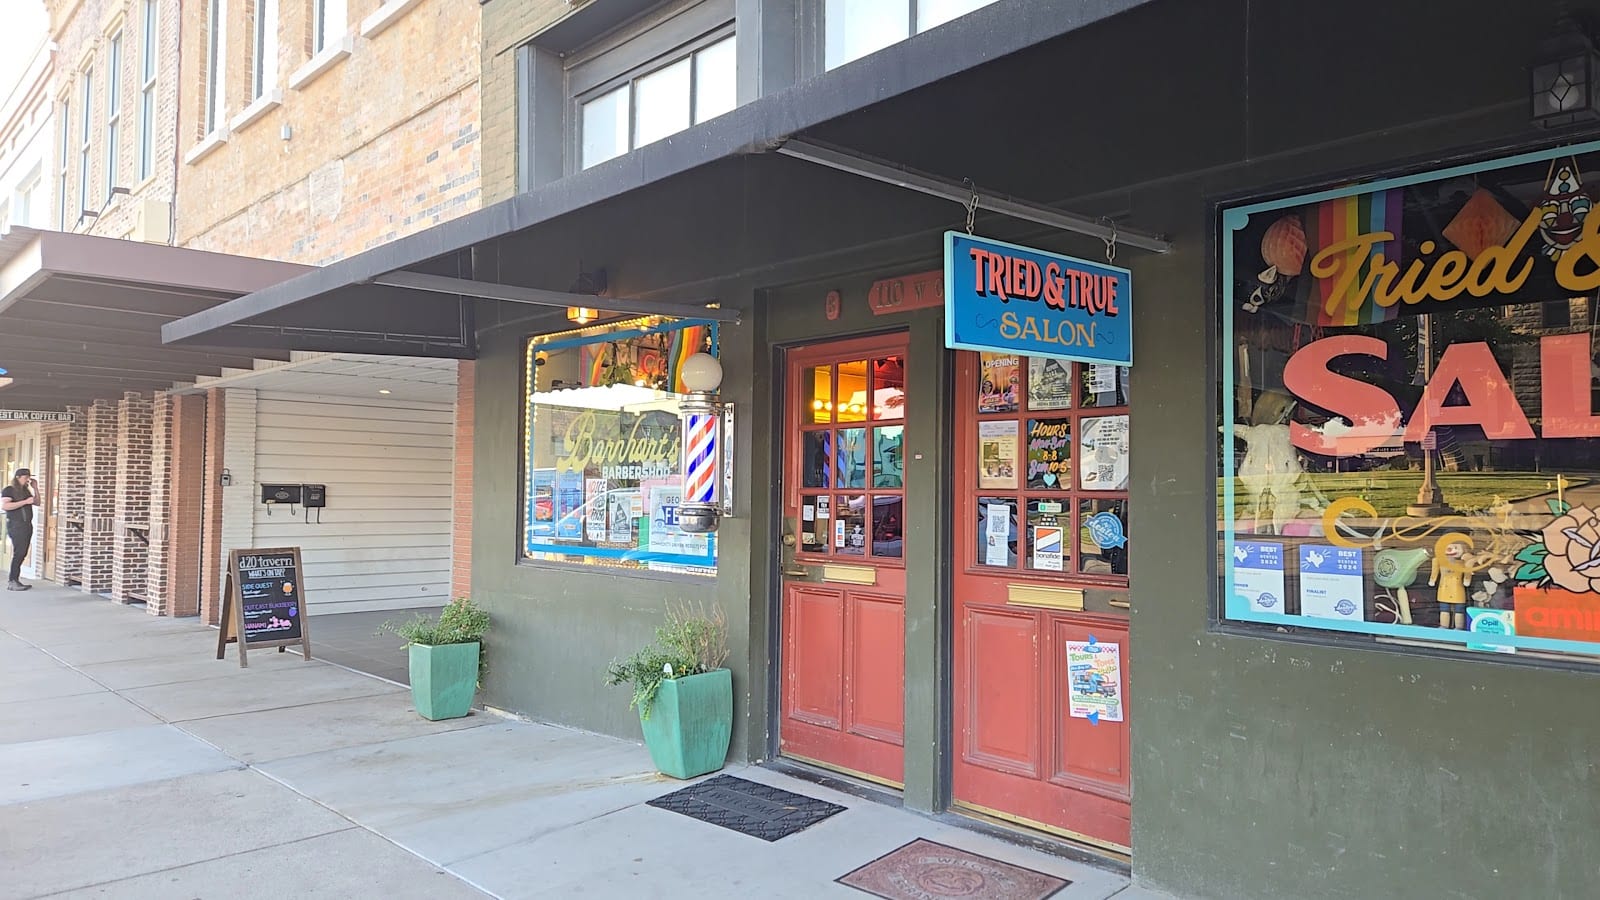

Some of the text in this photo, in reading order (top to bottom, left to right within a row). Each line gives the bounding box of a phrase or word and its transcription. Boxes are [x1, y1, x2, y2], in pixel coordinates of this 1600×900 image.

[1310, 205, 1539, 317] Tried
[970, 247, 1119, 317] TRIED & TRUE
[1000, 311, 1097, 348] SALON
[985, 358, 1019, 369] OPENING
[14, 411, 29, 420] OAK
[30, 412, 57, 421] COFFEE
[57, 413, 72, 421] BAR
[1031, 422, 1067, 438] HOURS
[557, 409, 681, 473] Barnhart's
[240, 556, 292, 569] d20 tavern
[248, 569, 267, 578] WHAT'S
[1481, 619, 1499, 627] Opill
